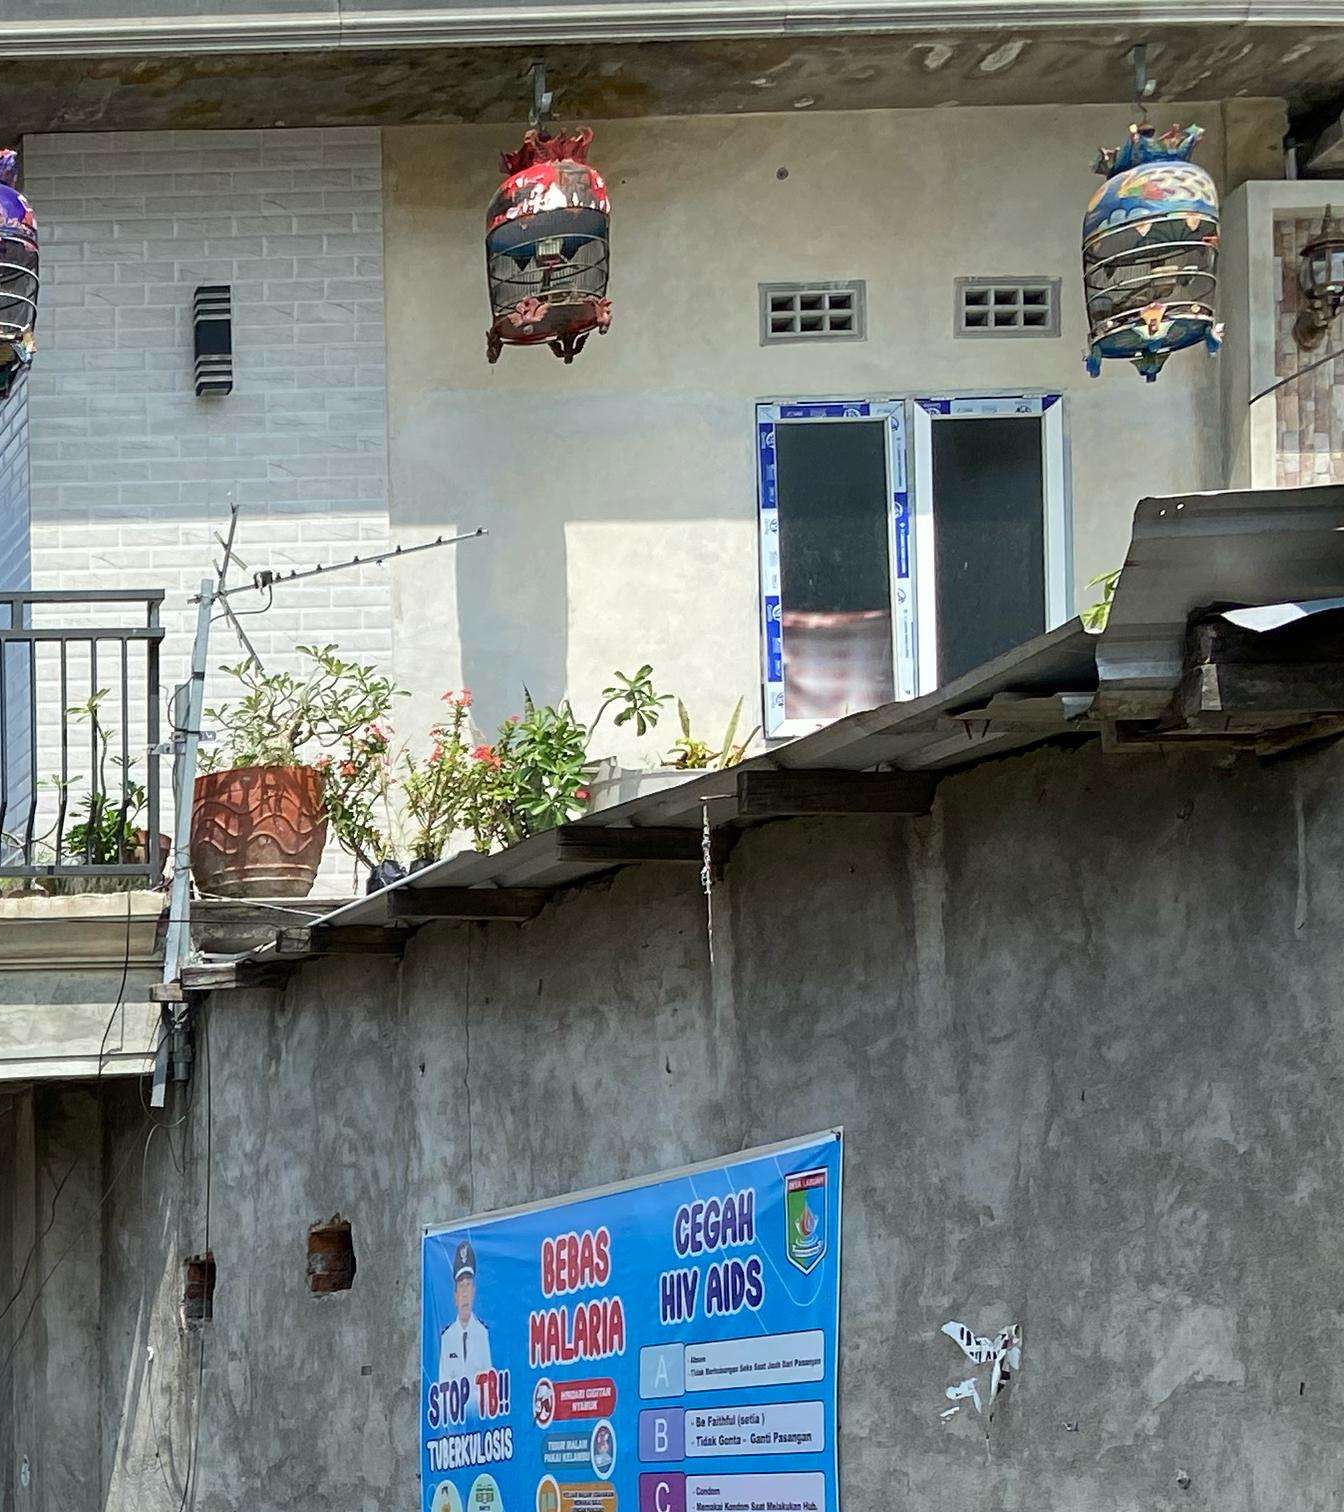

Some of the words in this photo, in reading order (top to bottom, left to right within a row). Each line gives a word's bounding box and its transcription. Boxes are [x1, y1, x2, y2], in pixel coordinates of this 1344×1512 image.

[674, 1190, 754, 1258] CEGAH
[542, 1224, 610, 1297] BEBAS
[660, 1267, 699, 1325] HIV
[705, 1253, 763, 1316] AIDS
[529, 1296, 624, 1366] MALARIA
[429, 1377, 469, 1429] STOP
[476, 1367, 509, 1418] TB!!
[654, 1354, 669, 1389] A
[428, 1429, 512, 1471] TUBERKULOSIS
[654, 1418, 668, 1453] B
[696, 1435, 716, 1447] Tidak
[750, 1432, 770, 1444] Ganti
[773, 1430, 811, 1446] Pasangan
